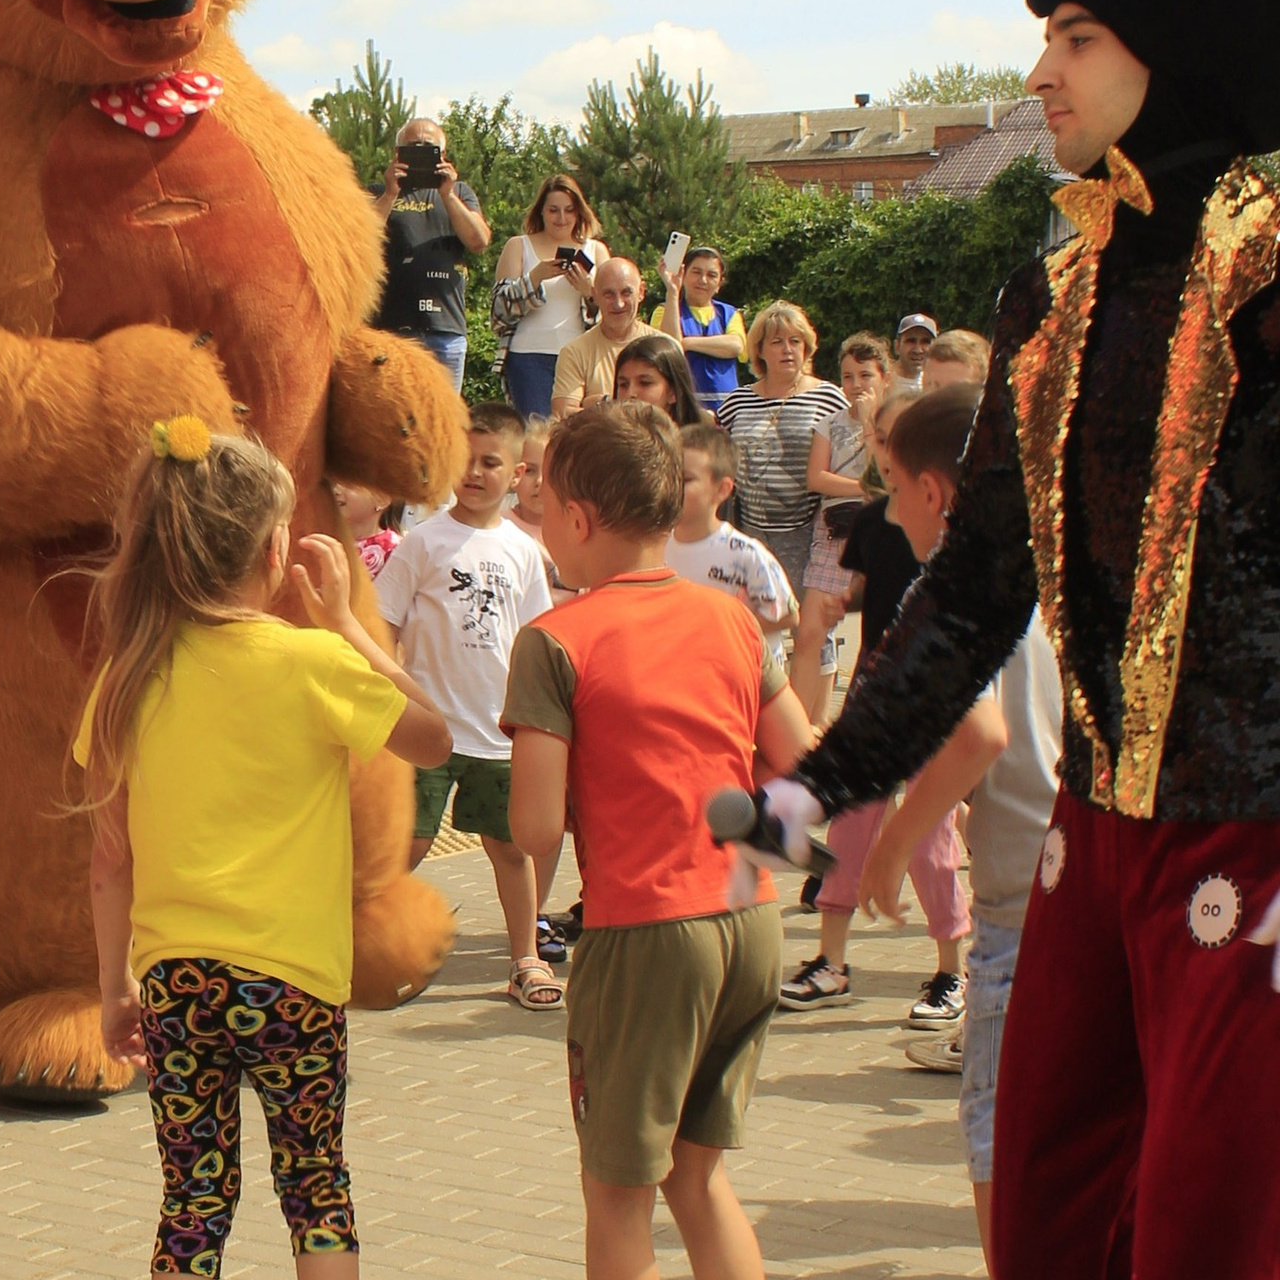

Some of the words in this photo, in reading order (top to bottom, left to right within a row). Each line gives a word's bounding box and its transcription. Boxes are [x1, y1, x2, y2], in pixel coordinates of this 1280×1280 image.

[419, 299, 433, 312] 68
[479, 561, 505, 574] DINO
[486, 575, 512, 589] CREW
